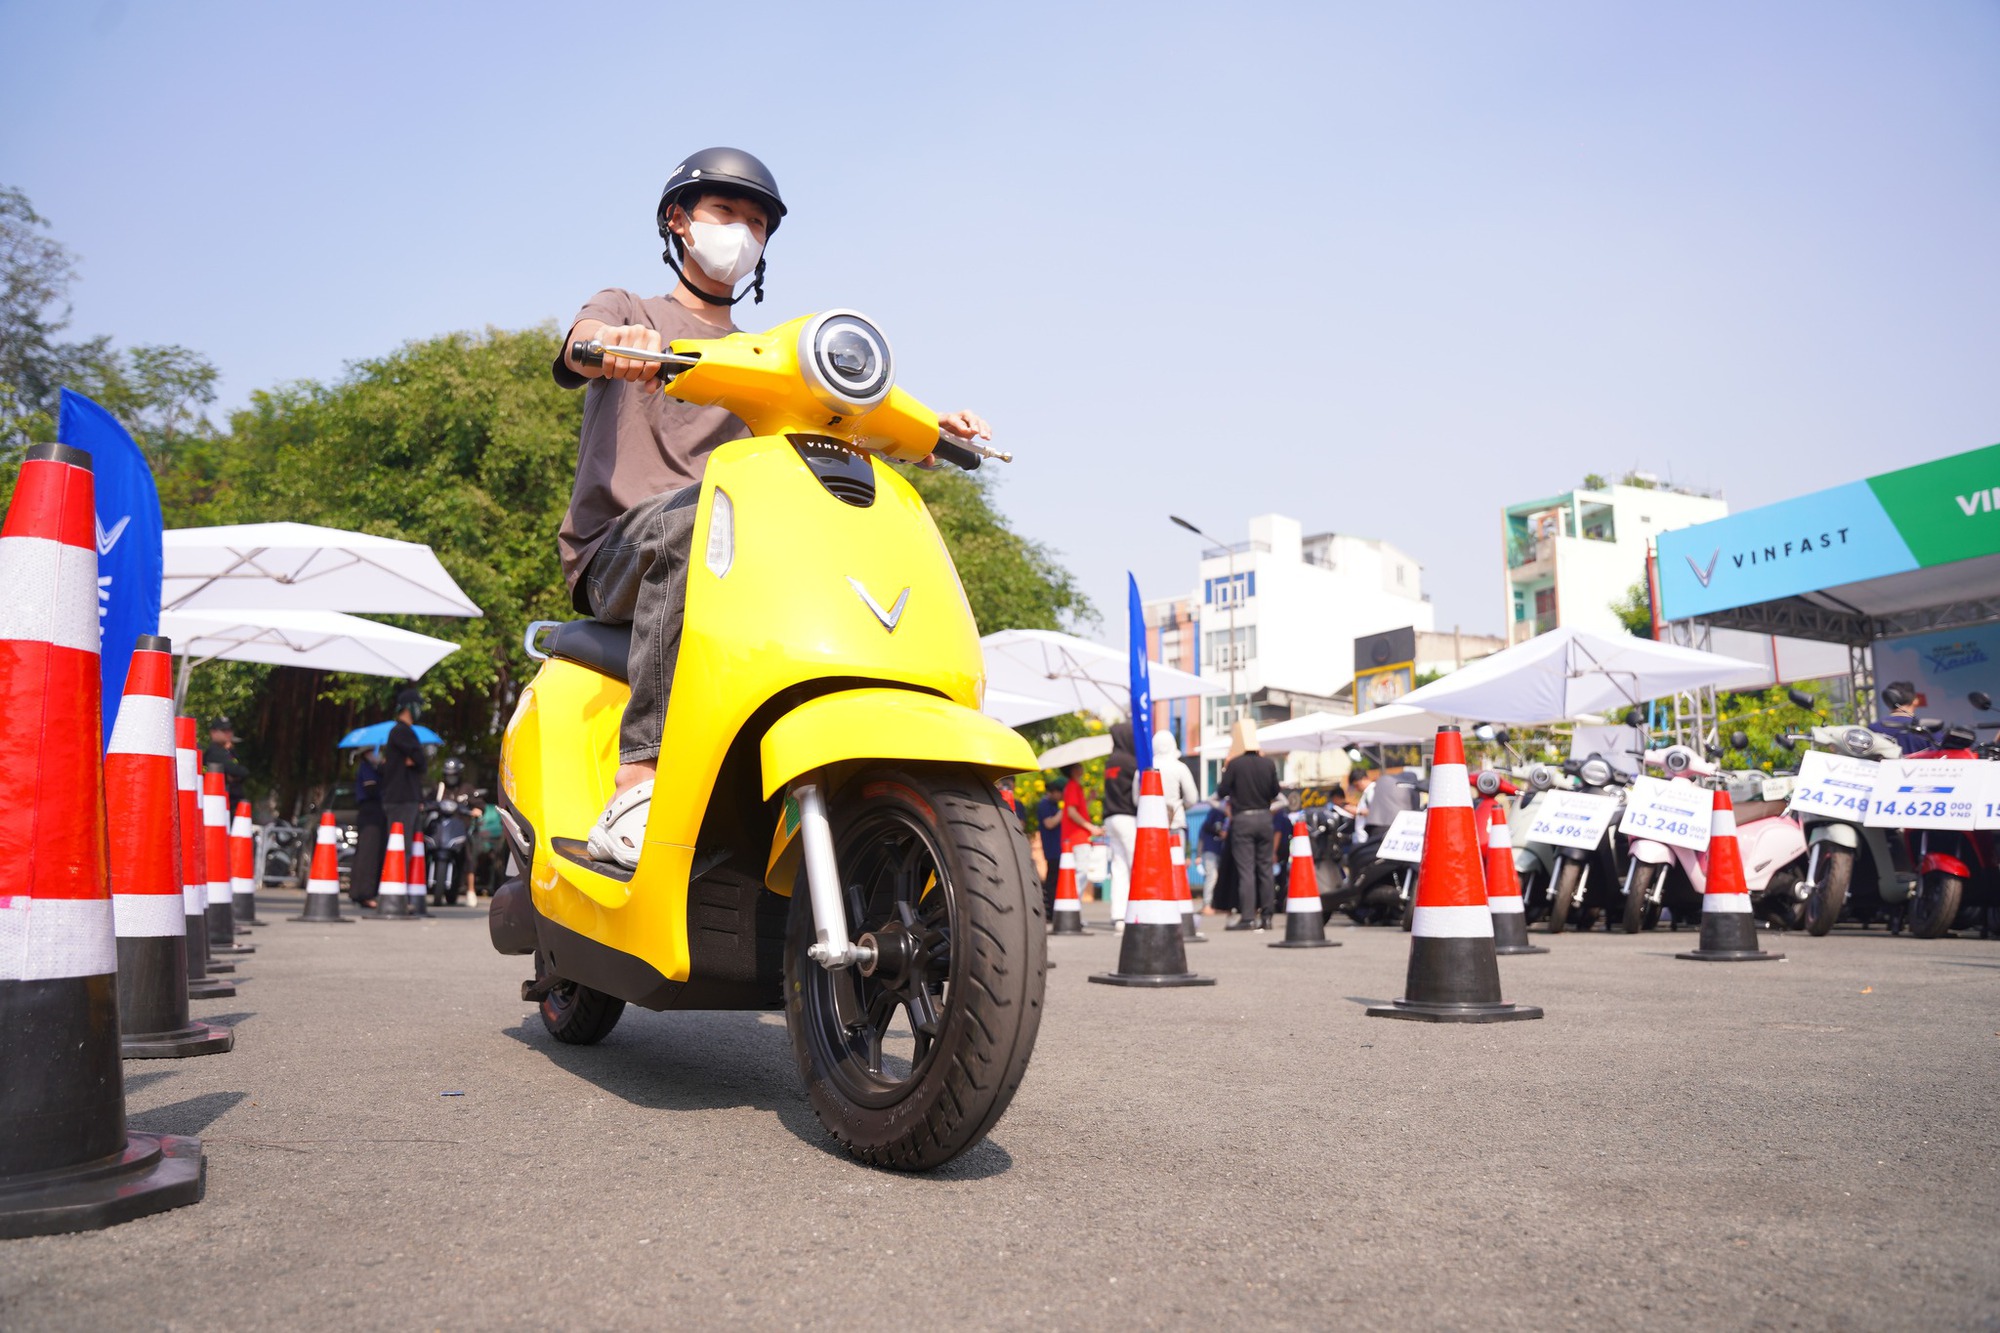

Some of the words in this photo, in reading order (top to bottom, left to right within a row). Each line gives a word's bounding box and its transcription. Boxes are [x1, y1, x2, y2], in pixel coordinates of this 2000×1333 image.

[1732, 527, 1849, 569] VINFAST
[1798, 788, 1870, 812] 24.748
[1875, 801, 1947, 817] 14.628
[1950, 802, 1973, 810] 000
[1533, 820, 1582, 838] 26.496
[1629, 811, 1689, 836] 13.248
